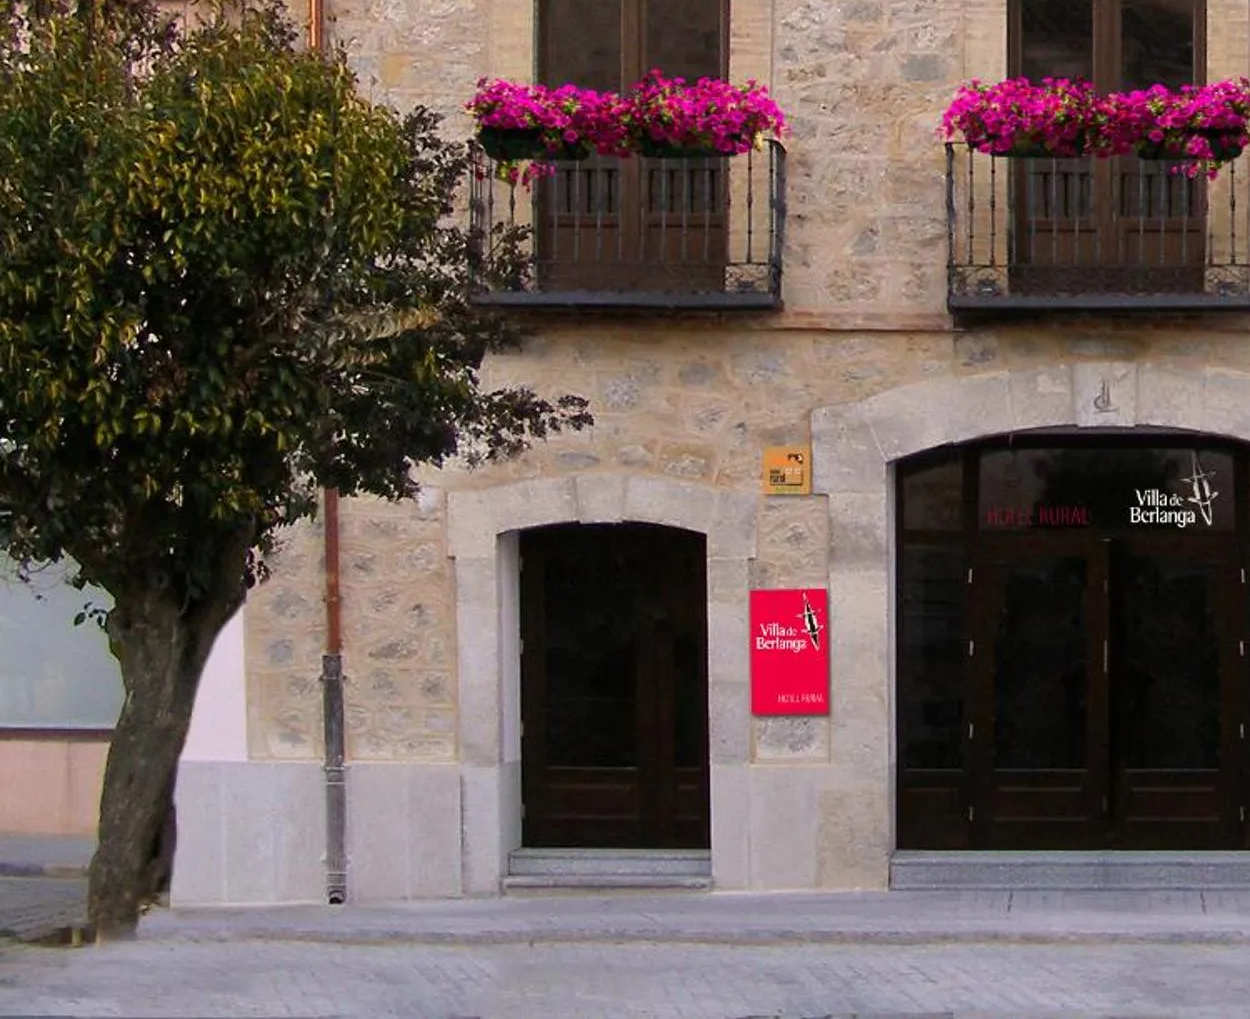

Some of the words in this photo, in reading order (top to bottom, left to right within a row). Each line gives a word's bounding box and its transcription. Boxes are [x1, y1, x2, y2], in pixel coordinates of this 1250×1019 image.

[1136, 488, 1168, 506] Villa
[1169, 495, 1184, 507] de
[1039, 505, 1090, 526] RURAL
[1130, 507, 1196, 528] Berlanga
[760, 622, 785, 637] Villa
[786, 627, 798, 637] de
[756, 636, 808, 653] Berlanga
